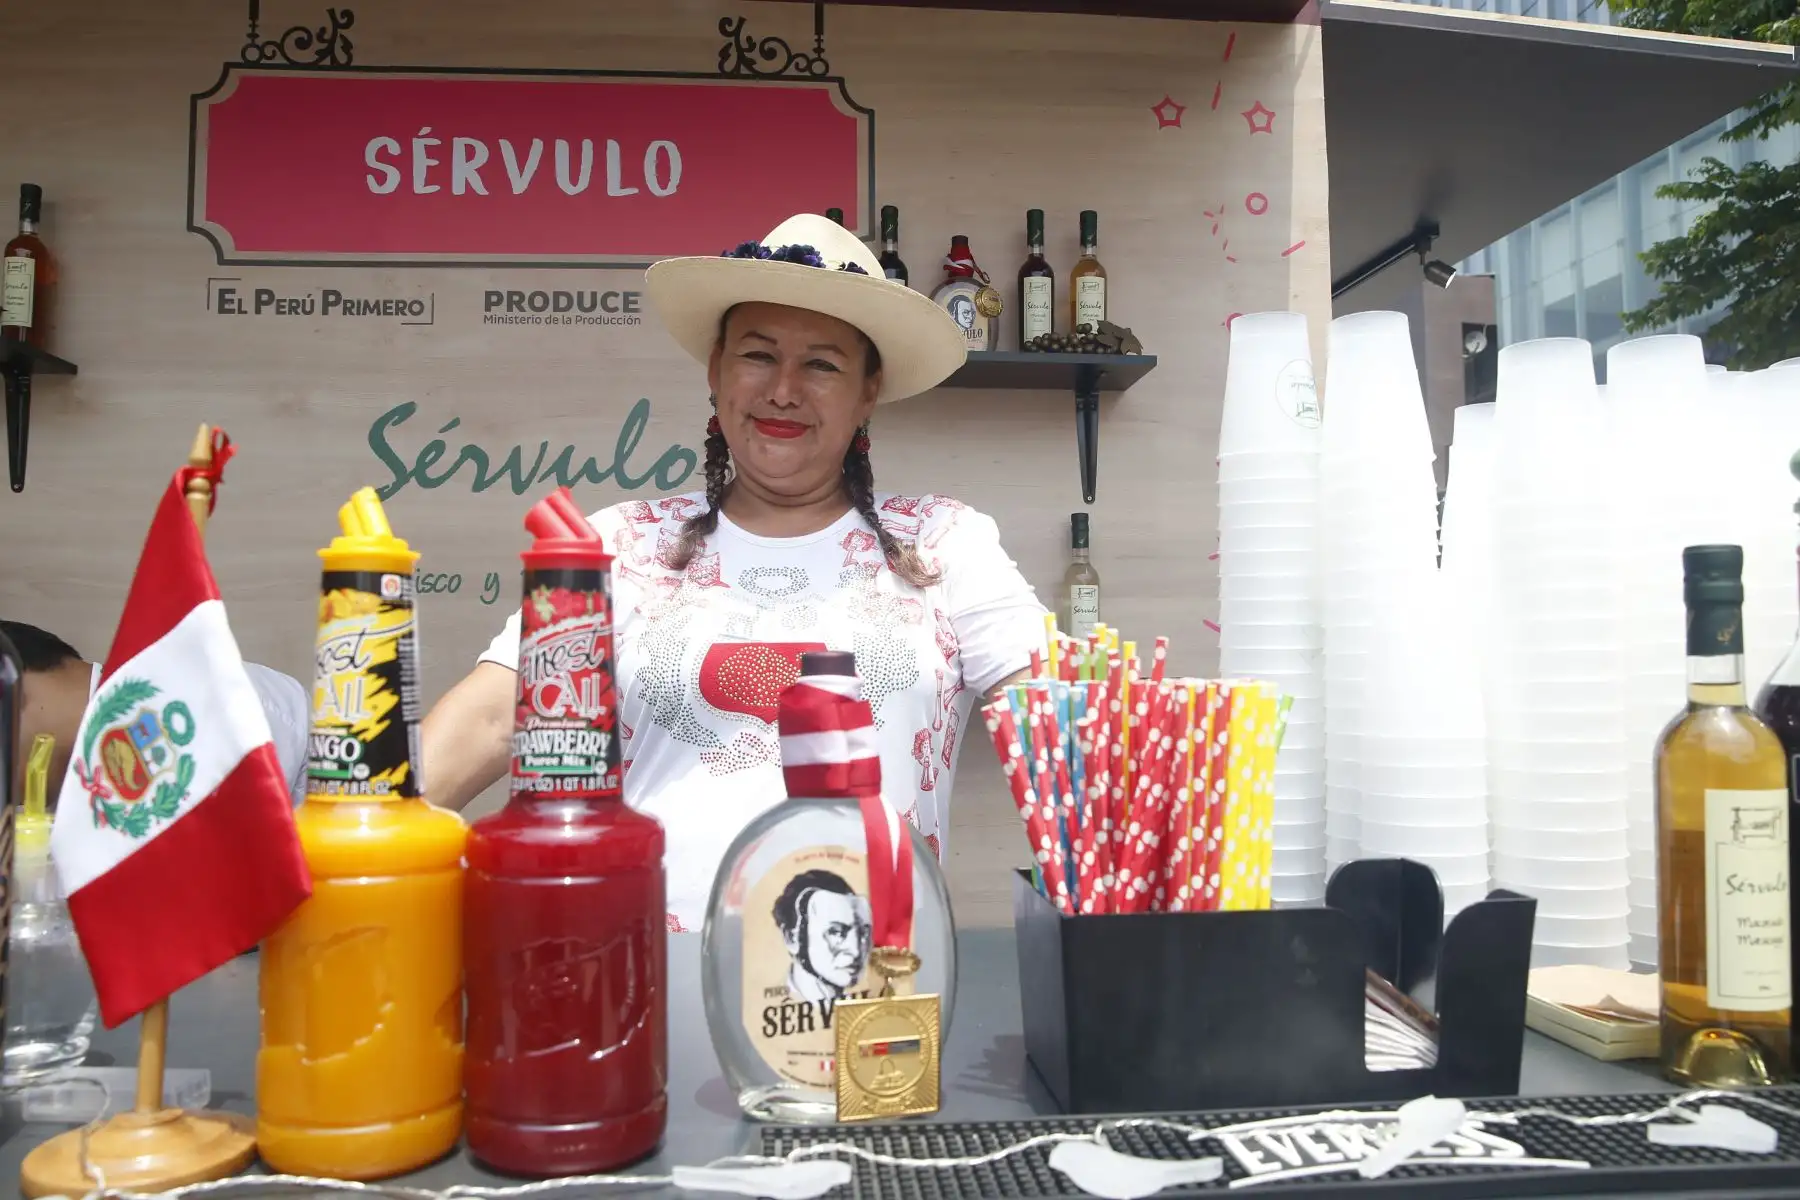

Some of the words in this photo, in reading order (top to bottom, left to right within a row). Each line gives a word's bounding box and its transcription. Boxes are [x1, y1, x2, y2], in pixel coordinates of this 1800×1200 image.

[365, 127, 682, 196] SÉRVULO
[484, 290, 642, 313] PRODUCE
[483, 314, 542, 325] Ministerio
[544, 315, 559, 325] de
[562, 315, 572, 325] la
[575, 314, 641, 326] Producción
[368, 398, 698, 502] Sérvulo
[415, 567, 462, 594] isco
[479, 572, 500, 605] y
[310, 735, 361, 762] NGO
